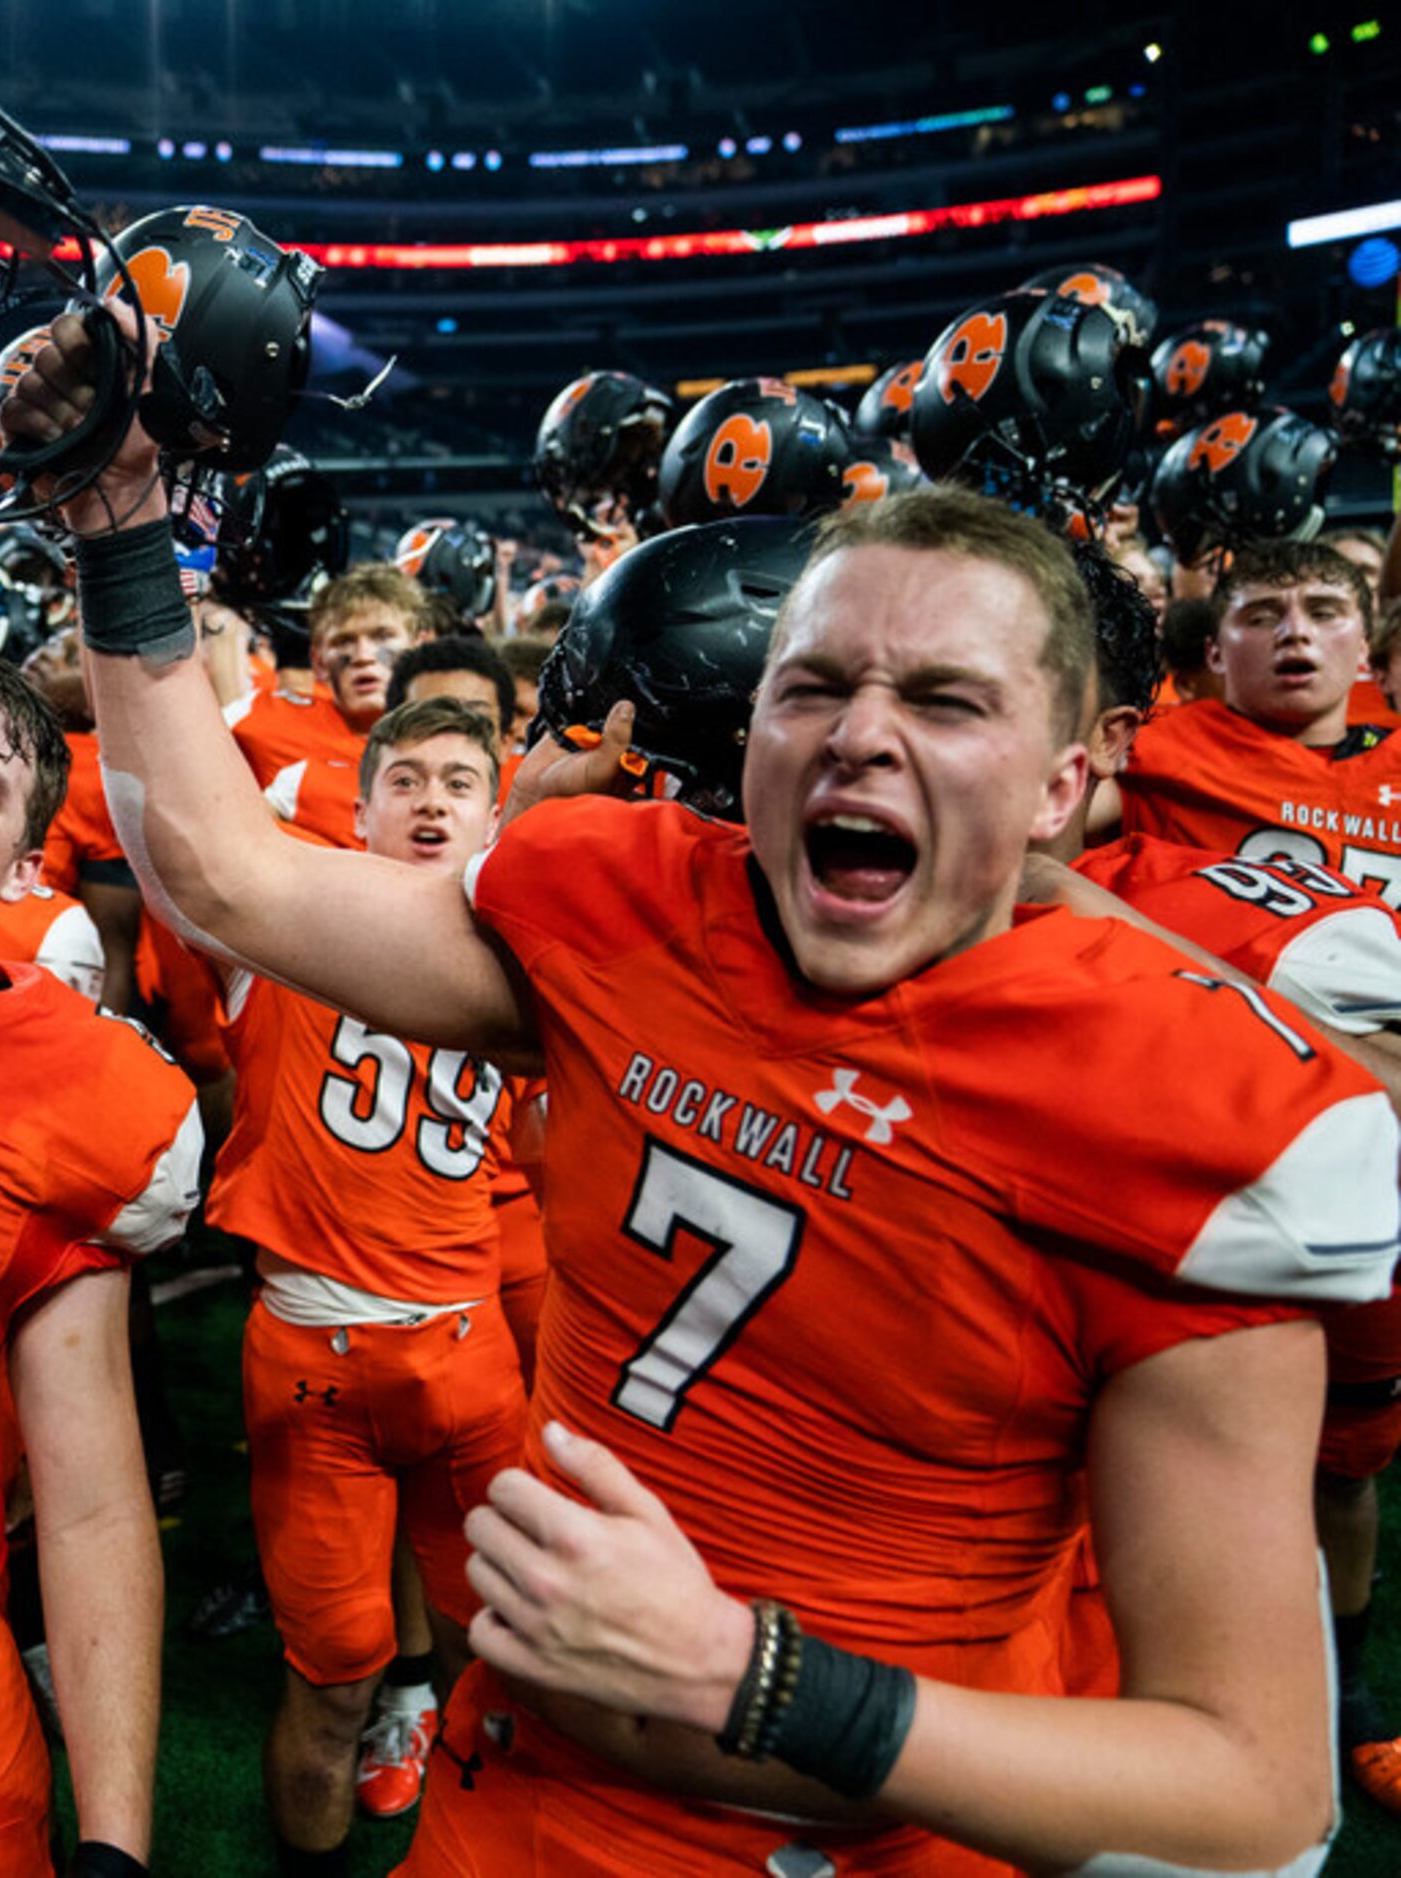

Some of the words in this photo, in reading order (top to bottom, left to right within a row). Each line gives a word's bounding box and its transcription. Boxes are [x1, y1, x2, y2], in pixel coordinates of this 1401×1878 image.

[1280, 801, 1401, 842] ROCKWALL
[319, 1014, 503, 1181] 59
[619, 1051, 856, 1200] ROCKWALL
[609, 1132, 807, 1435] 7
